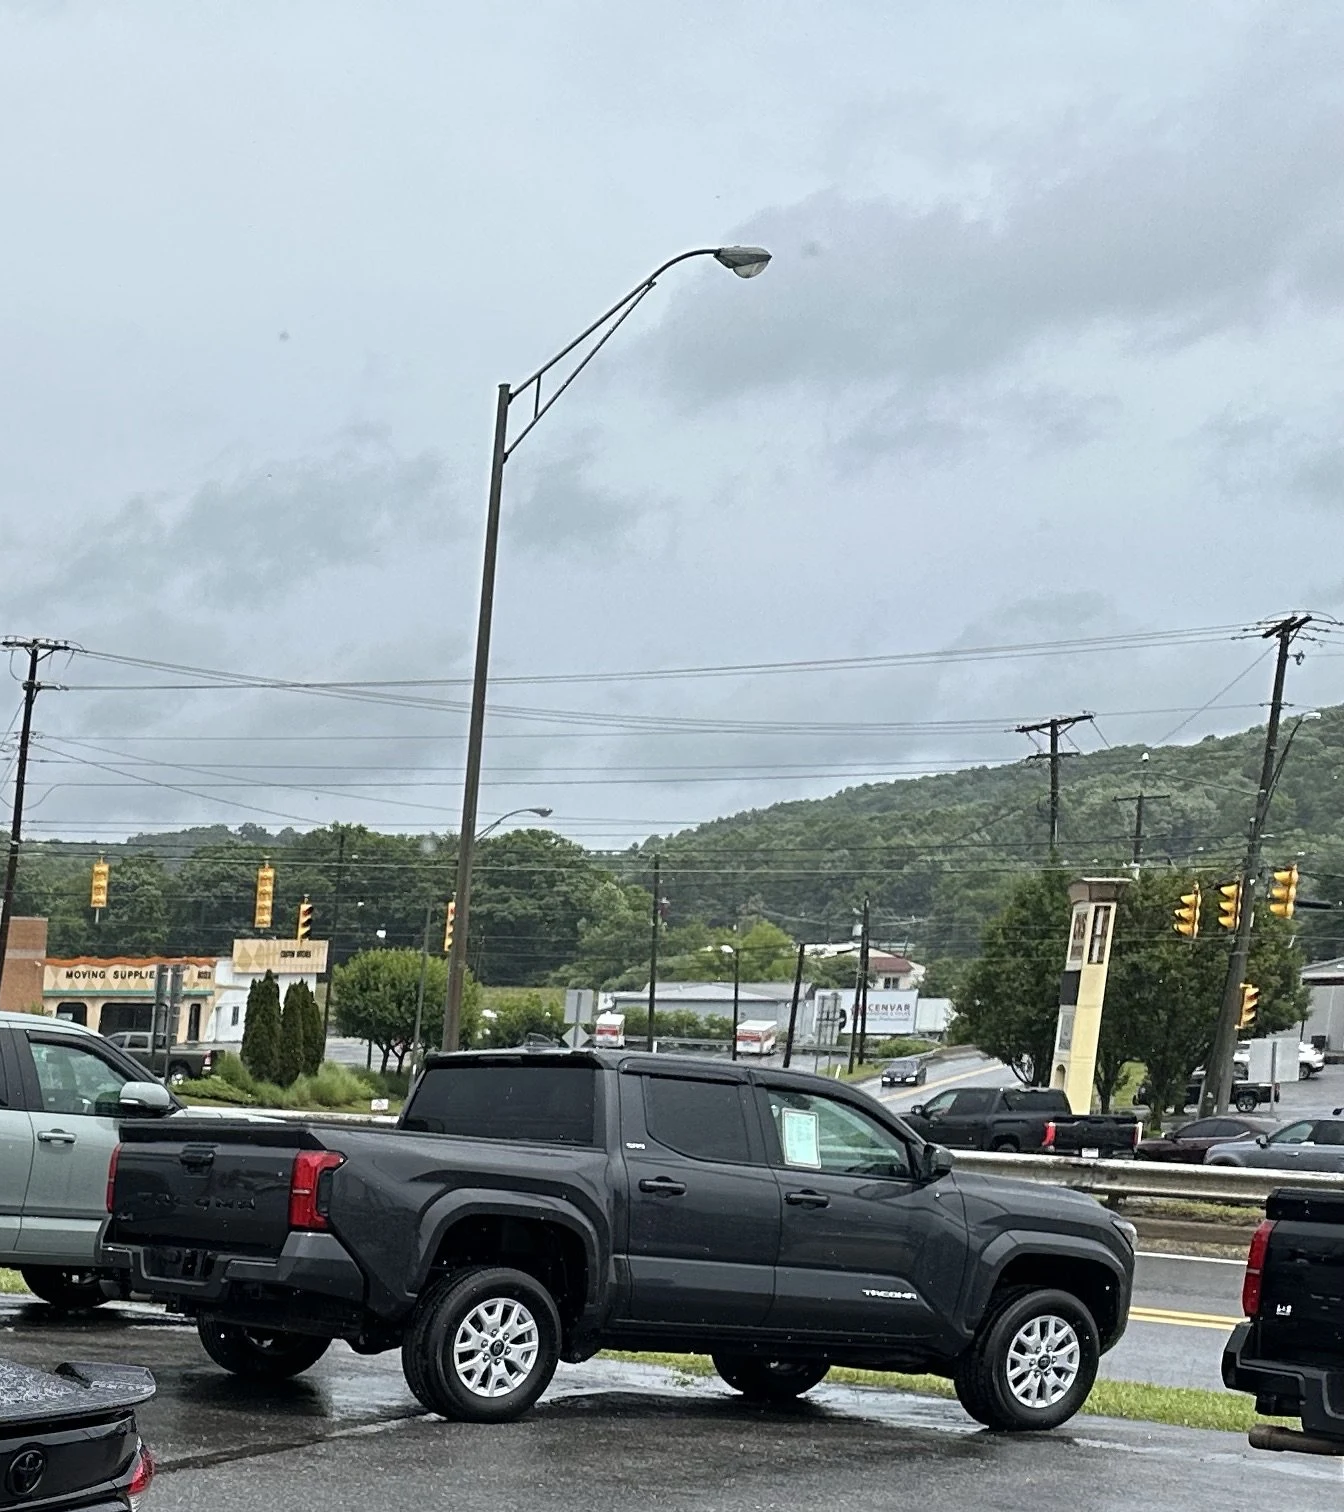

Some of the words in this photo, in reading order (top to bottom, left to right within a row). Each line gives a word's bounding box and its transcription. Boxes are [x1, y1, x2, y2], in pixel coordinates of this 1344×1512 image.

[66, 970, 106, 980] MOVING
[113, 970, 156, 980] SUPPLIE
[861, 1288, 918, 1300] TACOMA
